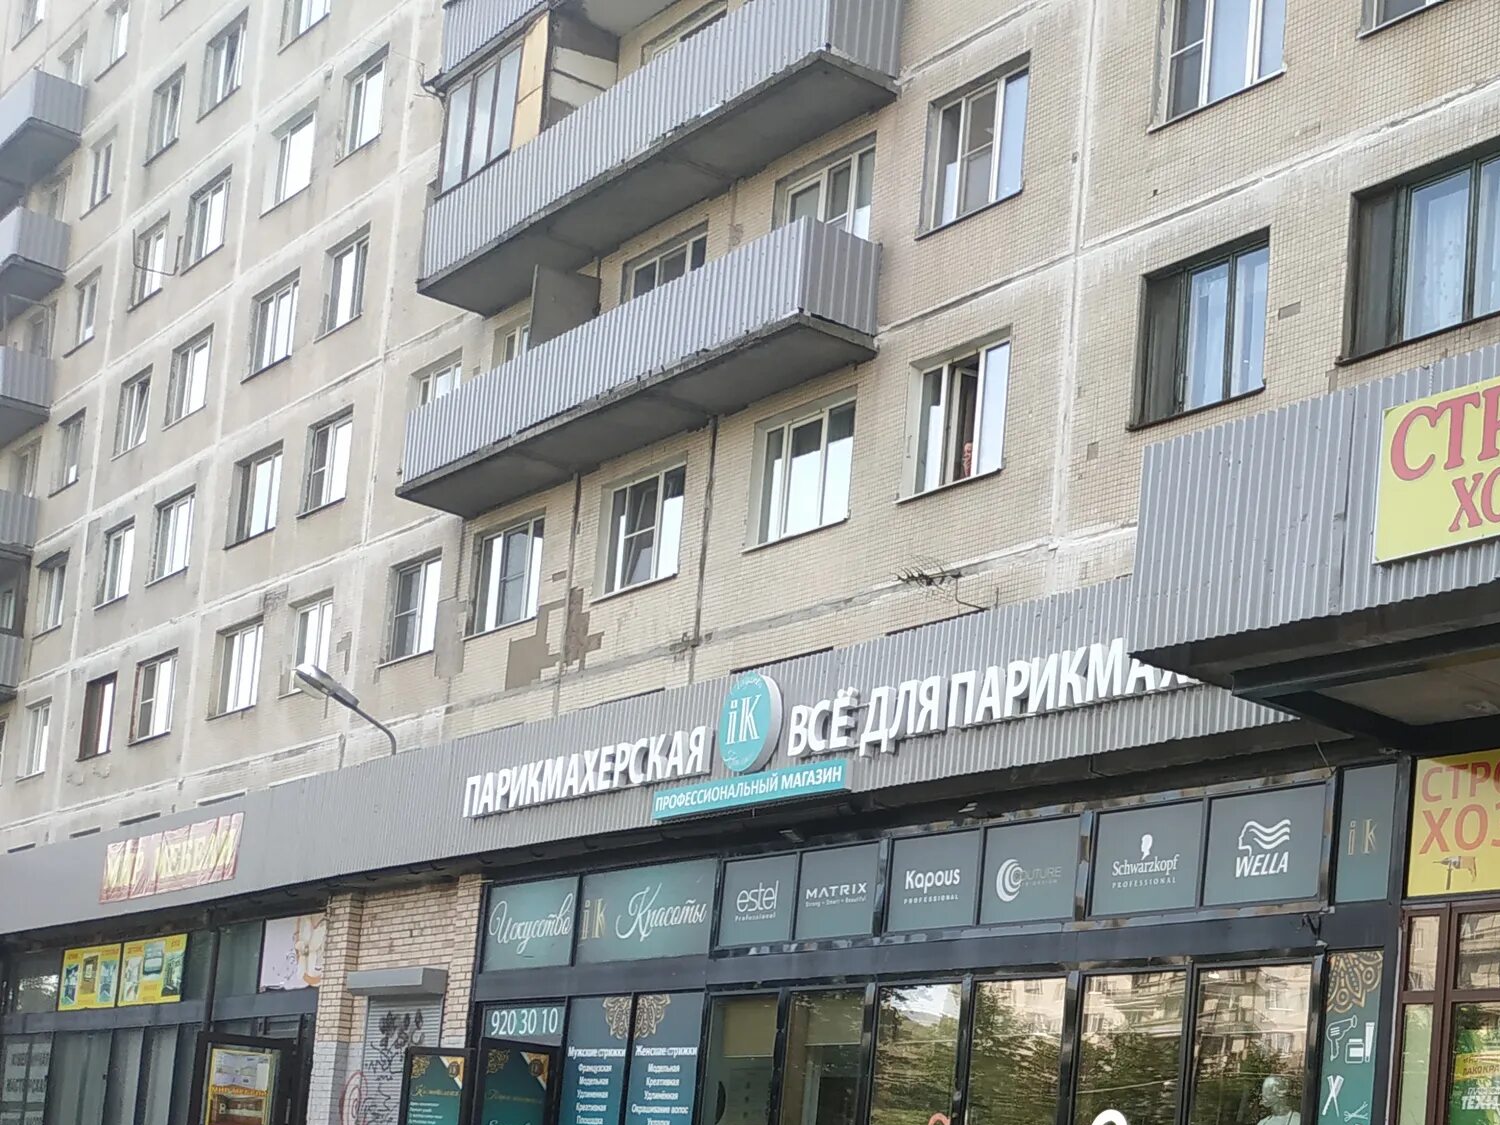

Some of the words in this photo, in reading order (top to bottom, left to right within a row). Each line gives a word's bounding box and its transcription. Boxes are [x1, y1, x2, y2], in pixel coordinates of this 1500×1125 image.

[788, 686, 856, 757] ВСЁ
[859, 676, 938, 757] ДЛЯ
[947, 637, 1200, 729] ПАРИКМА
[463, 726, 706, 818] ПАРИКМАХЕРСКАЯ
[655, 773, 779, 812] ПРОФЕССИОНАЛЬНЫЙ
[780, 765, 842, 791] МАГАЗИН
[1112, 854, 1180, 877] Schwarzkopf
[1234, 851, 1289, 878] WELLA
[805, 881, 868, 900] MATRIX
[904, 867, 961, 896] Kapous
[1112, 877, 1177, 888] PROFESSIONAL
[736, 879, 779, 914] estel
[904, 894, 960, 905] PROFESSIONAL
[488, 892, 575, 955] Искусство
[615, 882, 708, 942] Красоты
[490, 1009, 516, 1036] 920
[519, 1009, 538, 1035] 30
[541, 1007, 559, 1034] 10
